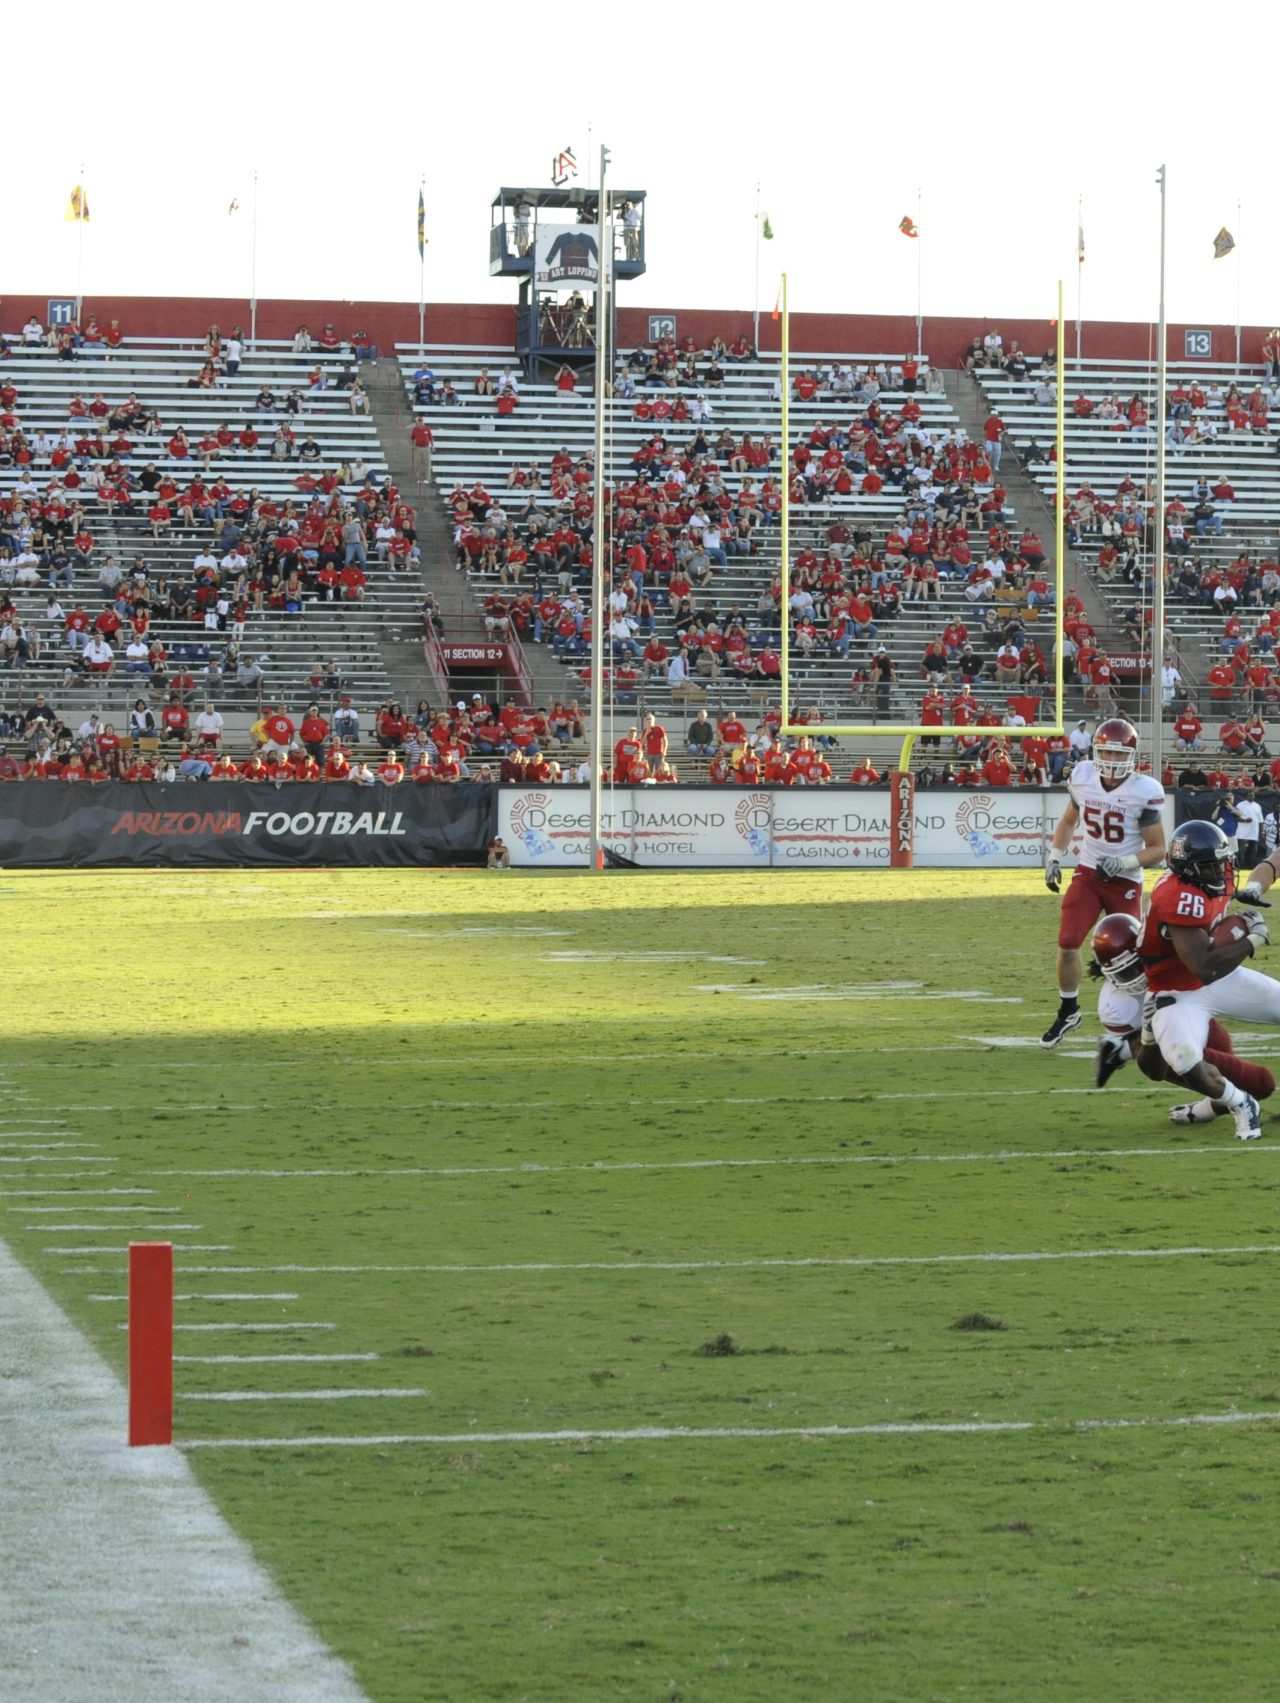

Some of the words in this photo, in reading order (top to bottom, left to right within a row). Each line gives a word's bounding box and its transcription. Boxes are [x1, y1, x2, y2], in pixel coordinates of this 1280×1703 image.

[551, 267, 565, 278] ART
[52, 304, 72, 323] 11
[651, 319, 675, 338] 12
[1187, 334, 1210, 353] 13
[443, 649, 451, 659] 11
[452, 648, 485, 659] SECTION
[486, 649, 496, 659] 12
[111, 811, 242, 836] ARIZONA
[242, 811, 406, 836] FOOTBALL
[897, 777, 912, 851] ARIZONA
[1083, 806, 1126, 843] 56
[644, 842, 697, 855] HOTEL
[786, 847, 849, 859] CASINO
[1176, 891, 1205, 918] 26
